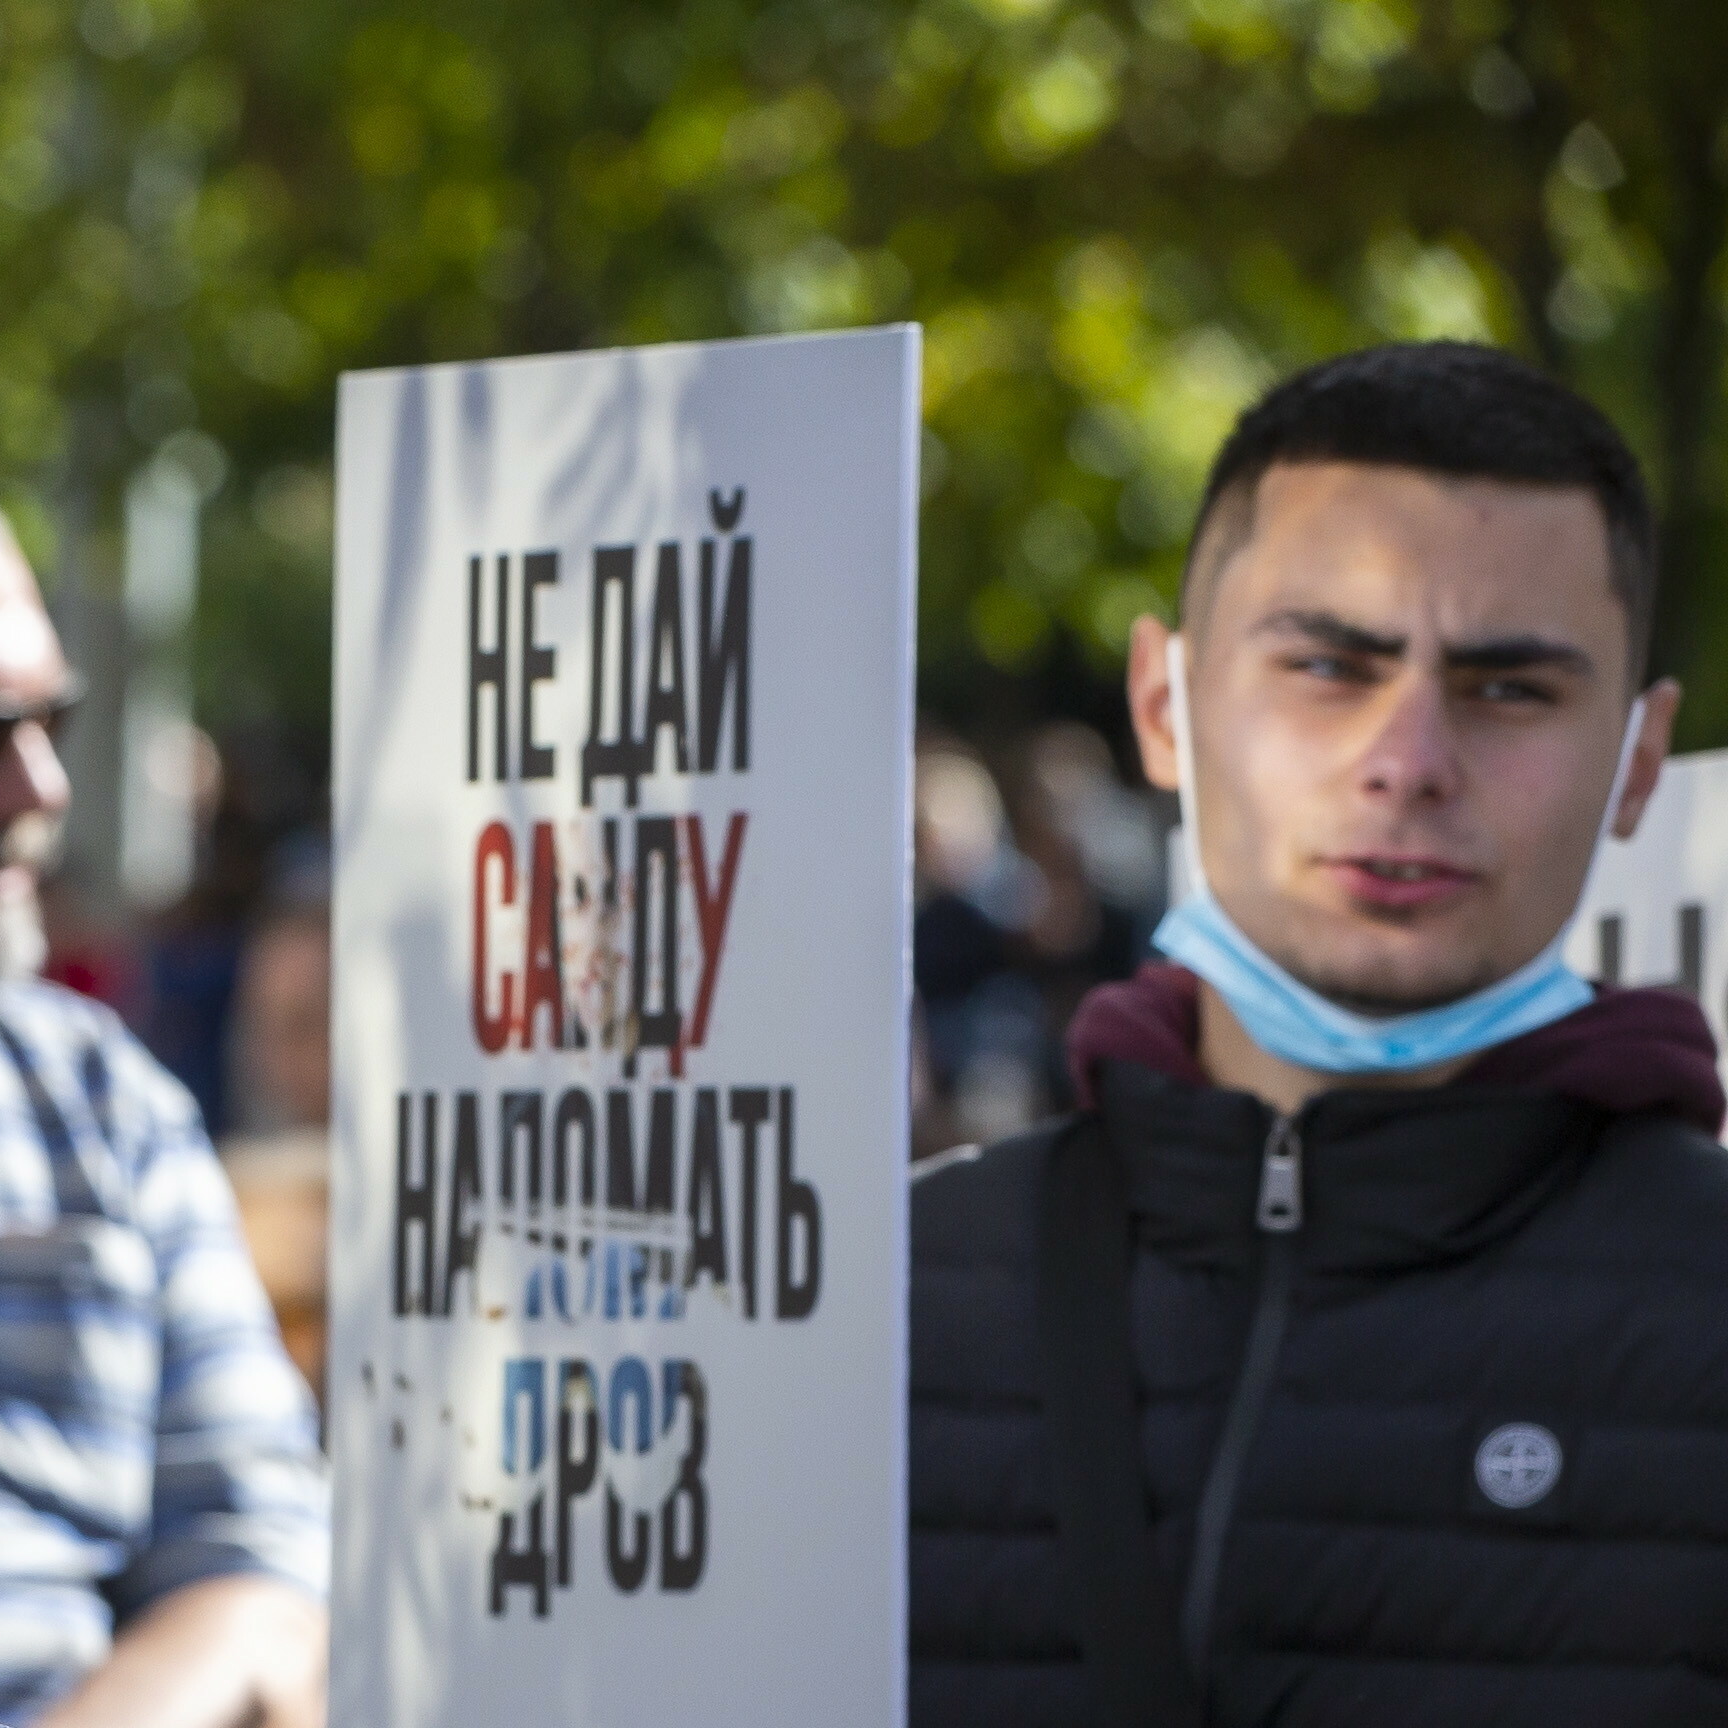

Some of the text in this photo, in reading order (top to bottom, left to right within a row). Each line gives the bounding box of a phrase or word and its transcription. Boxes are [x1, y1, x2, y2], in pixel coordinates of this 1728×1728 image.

[467, 486, 754, 811] НЕ ДАЙ
[487, 1357, 711, 1621] ДРОВ
